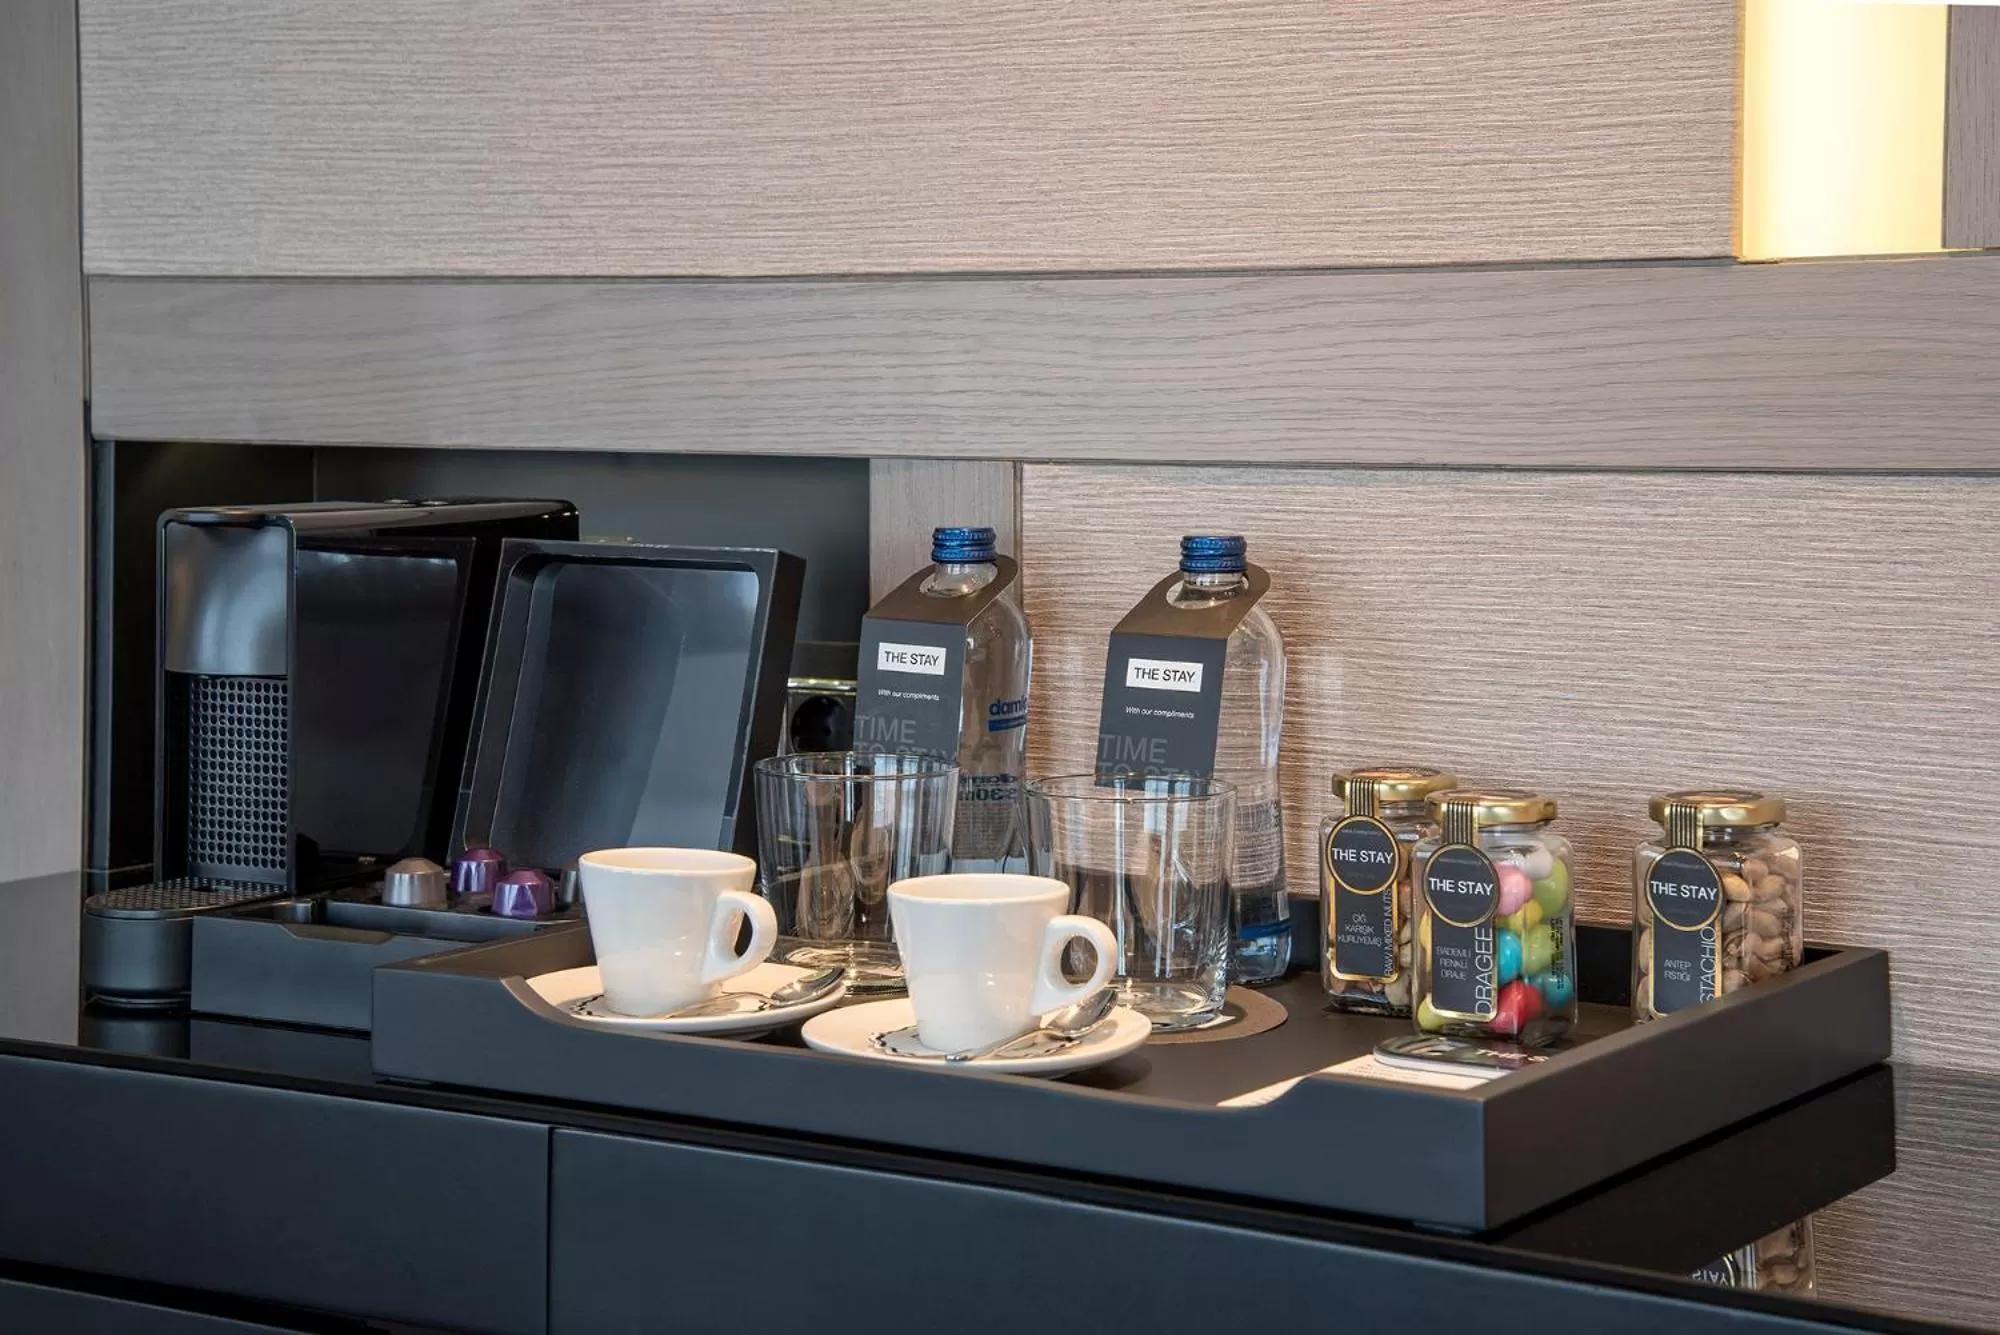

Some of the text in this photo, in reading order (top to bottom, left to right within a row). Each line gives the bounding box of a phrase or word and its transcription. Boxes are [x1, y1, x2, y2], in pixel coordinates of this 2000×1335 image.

[884, 650, 940, 666] THE STAY
[1134, 667, 1196, 683] THE STAY
[1125, 706, 1140, 714] With
[1153, 710, 1194, 719] compliments
[855, 714, 916, 744] TIME
[1100, 734, 1168, 764] TIME
[1332, 848, 1394, 865] THE STAY
[1428, 877, 1494, 896] THE STAY
[1650, 880, 1718, 901] THE STAY
[1383, 888, 1392, 917] NUTS
[1475, 927, 1493, 1014] DRAGEE
